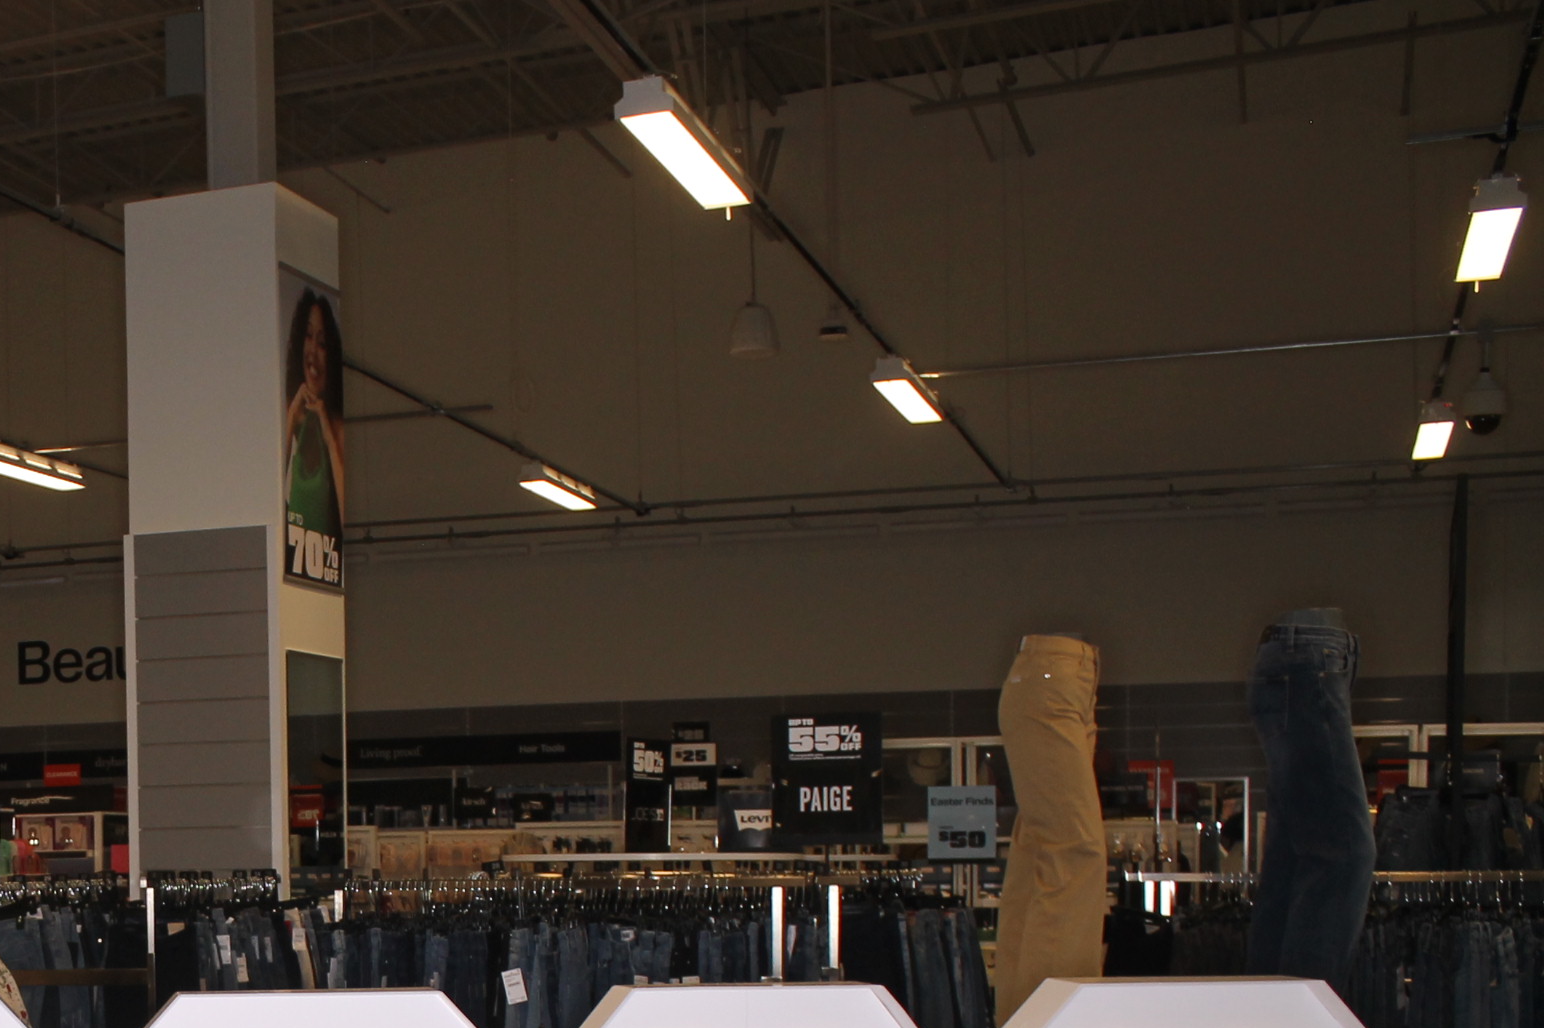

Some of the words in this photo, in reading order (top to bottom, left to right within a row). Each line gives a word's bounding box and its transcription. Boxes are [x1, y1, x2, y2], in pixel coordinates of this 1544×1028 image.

[324, 566, 339, 583] OFF
[840, 742, 862, 751] OFF
[799, 786, 853, 812] PAIGE
[930, 797, 963, 806] Easter
[965, 796, 994, 806] Finds
[938, 831, 986, 848] $50
